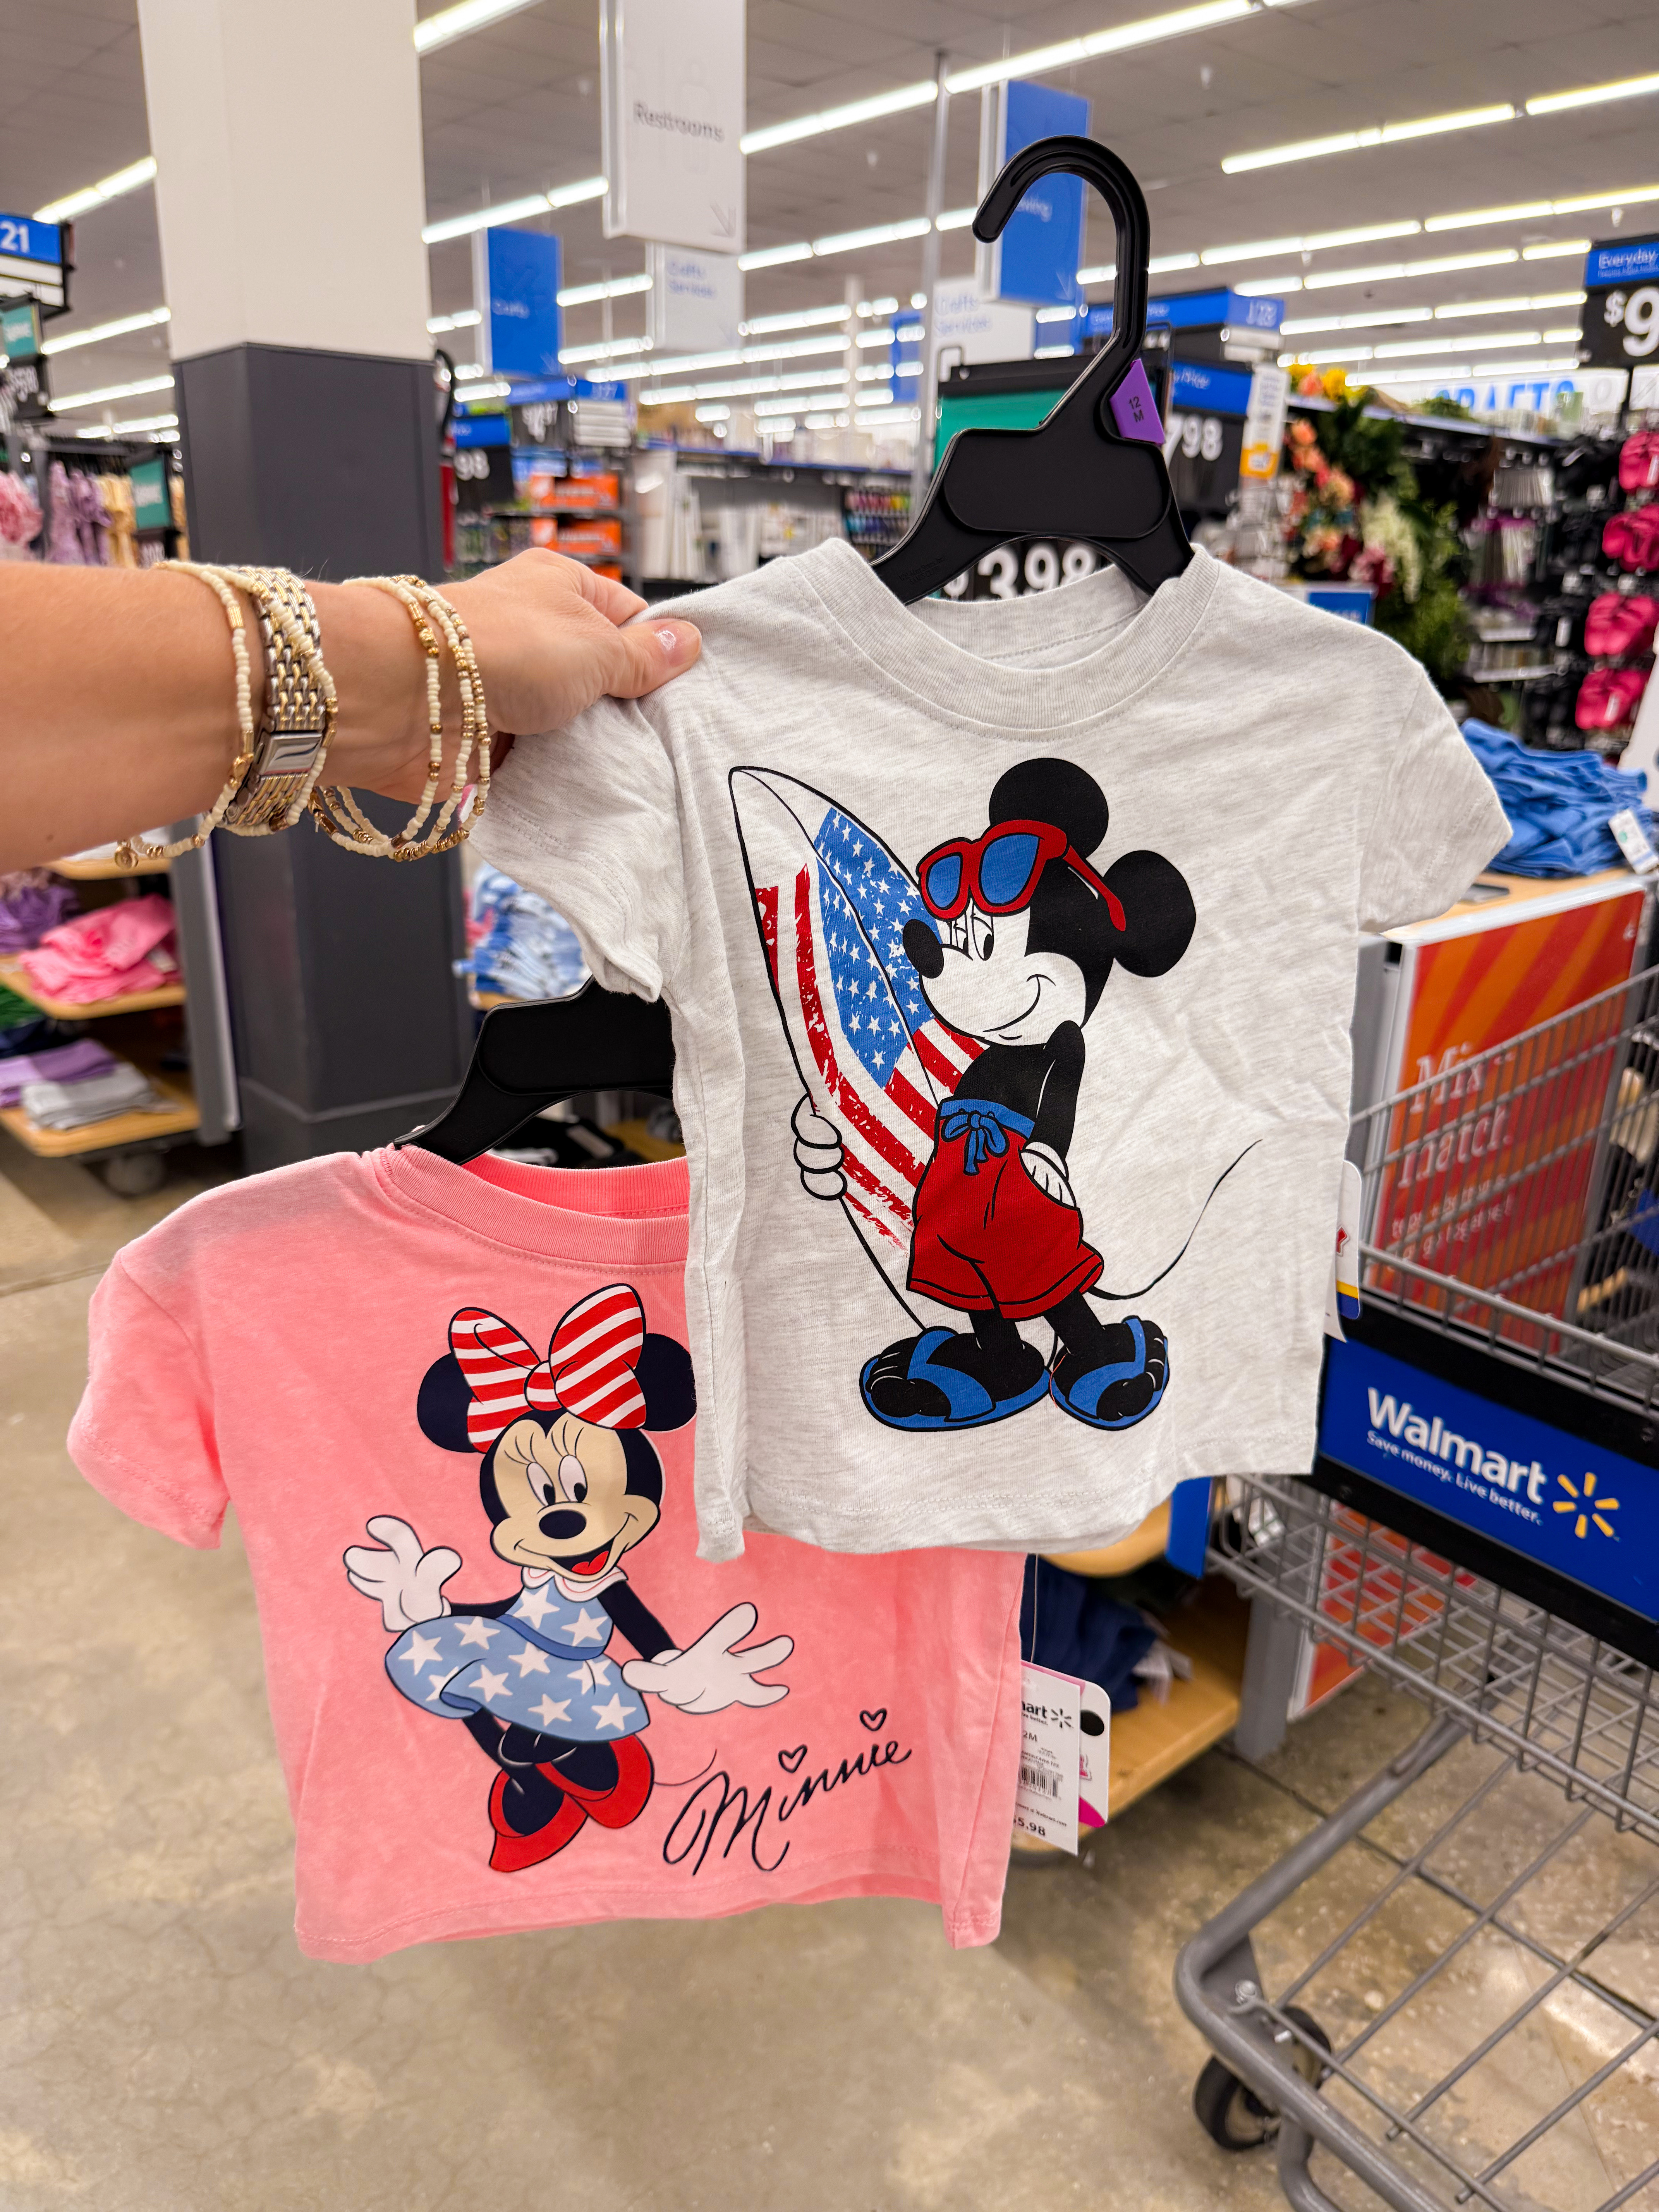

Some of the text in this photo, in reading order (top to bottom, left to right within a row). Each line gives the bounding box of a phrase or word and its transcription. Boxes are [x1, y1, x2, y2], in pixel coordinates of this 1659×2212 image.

[633, 100, 725, 143] Restrooms
[1129, 396, 1142, 410] 12
[1133, 409, 1144, 423] M
[1367, 1386, 1547, 1506] Walmart
[1367, 1430, 1544, 1527] Save money. Live better.
[663, 1708, 912, 1876] Minnie
